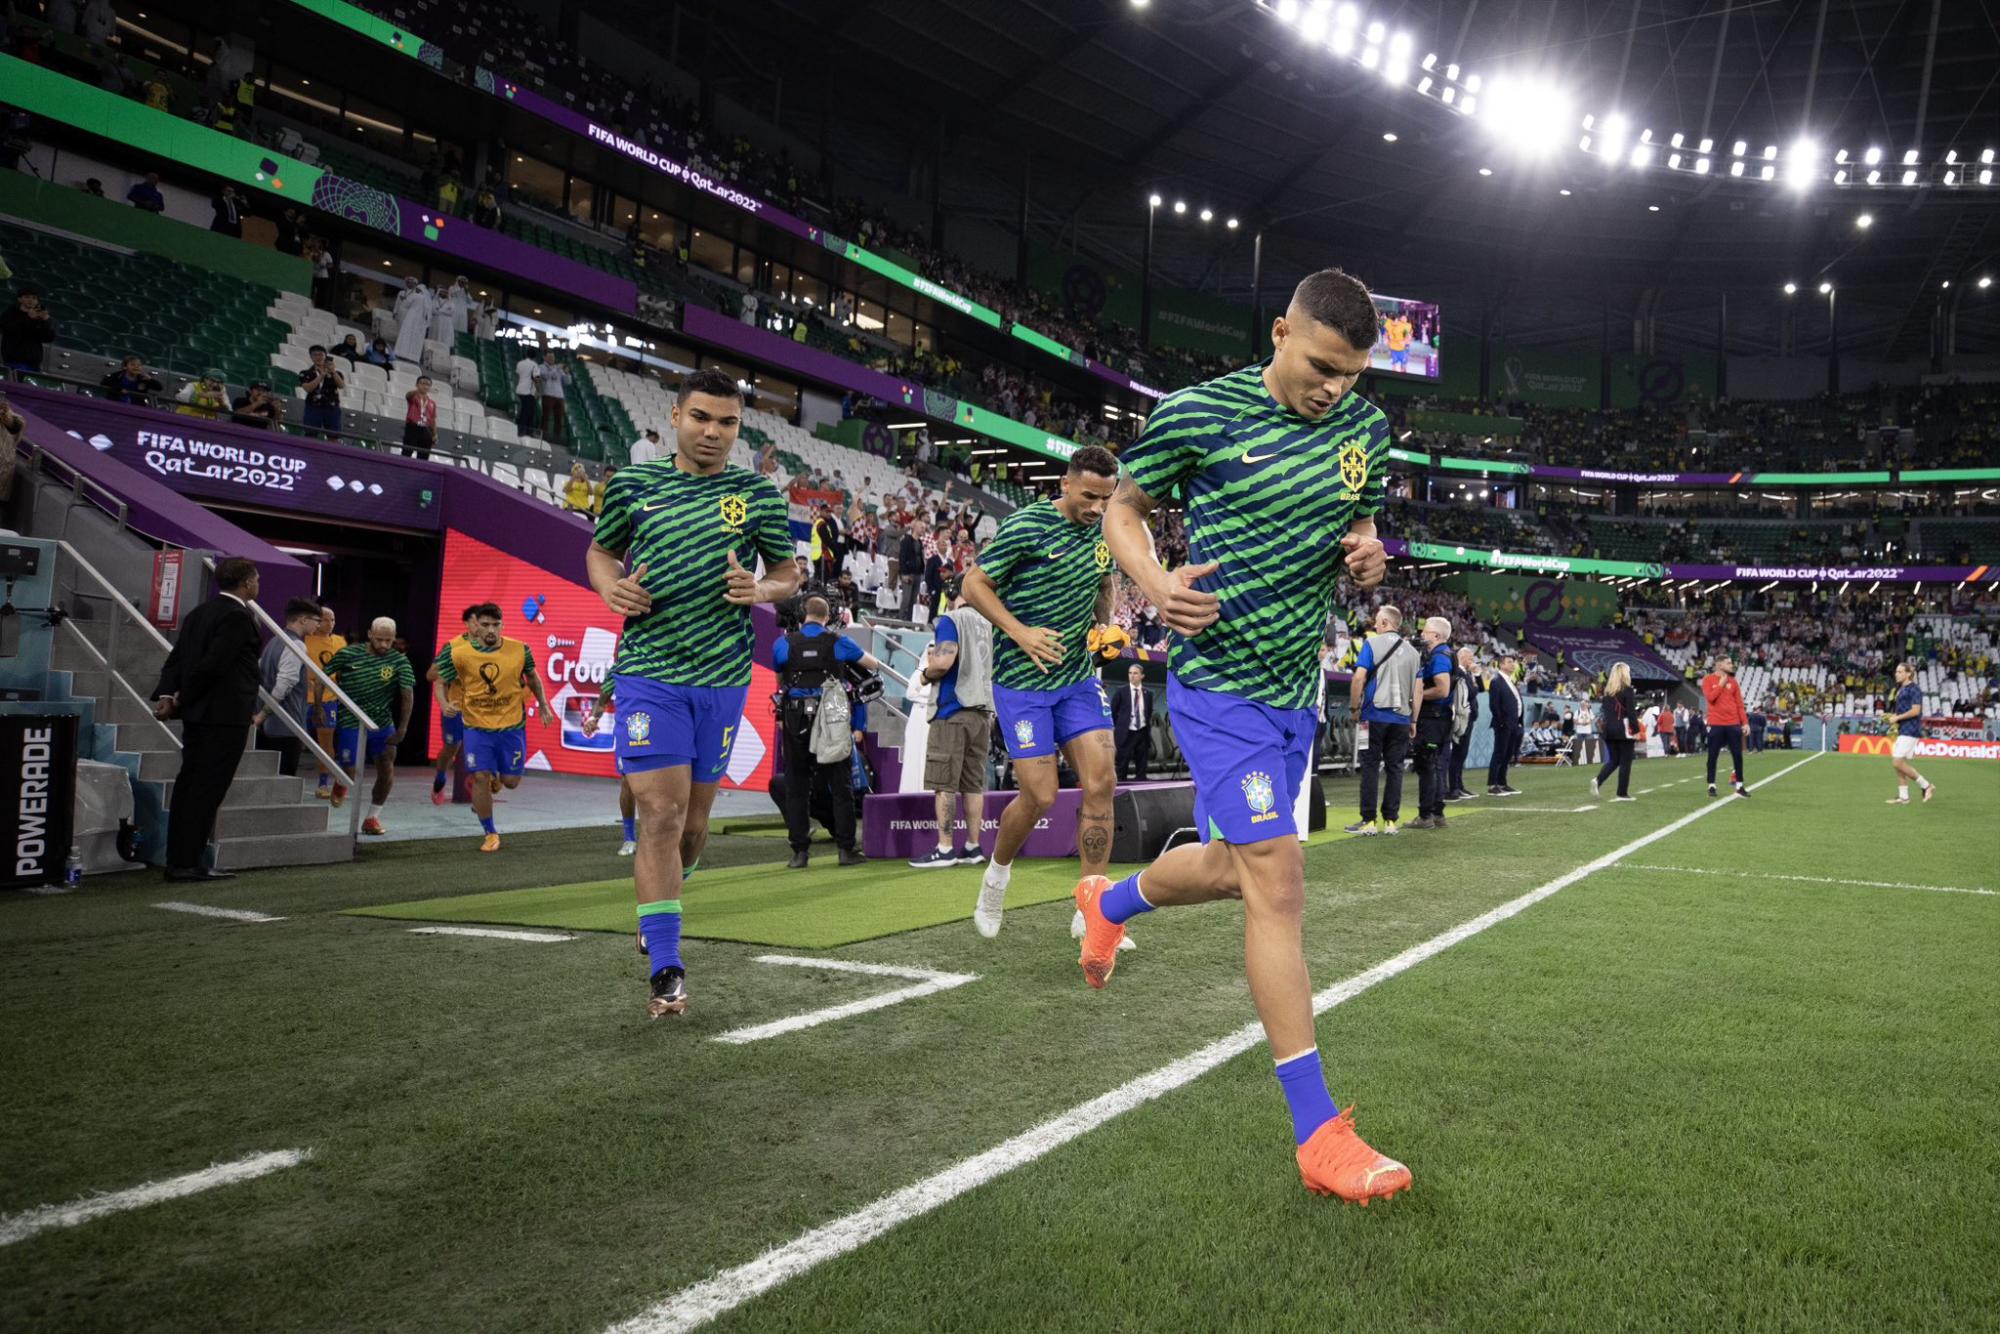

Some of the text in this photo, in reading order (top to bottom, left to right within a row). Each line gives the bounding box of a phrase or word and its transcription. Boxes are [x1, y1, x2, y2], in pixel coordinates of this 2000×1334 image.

[588, 123, 615, 147] FIFA
[616, 135, 658, 166] WORLD
[659, 158, 682, 176] CUP
[137, 430, 307, 473] FIFA WORLD CUP
[1581, 470, 1595, 478] FIFA
[1595, 471, 1616, 480] WORLD
[1616, 473, 1628, 481] CUP
[1736, 567, 1758, 578] FIFA
[1759, 567, 1796, 579] WORLD
[1797, 568, 1818, 579] CUP
[720, 725, 735, 759] 5
[513, 751, 522, 767] 7
[16, 727, 52, 876] POWERADE
[890, 820, 912, 830] FIFA
[912, 819, 939, 830] WORL
[1251, 811, 1279, 824] BRASIL
